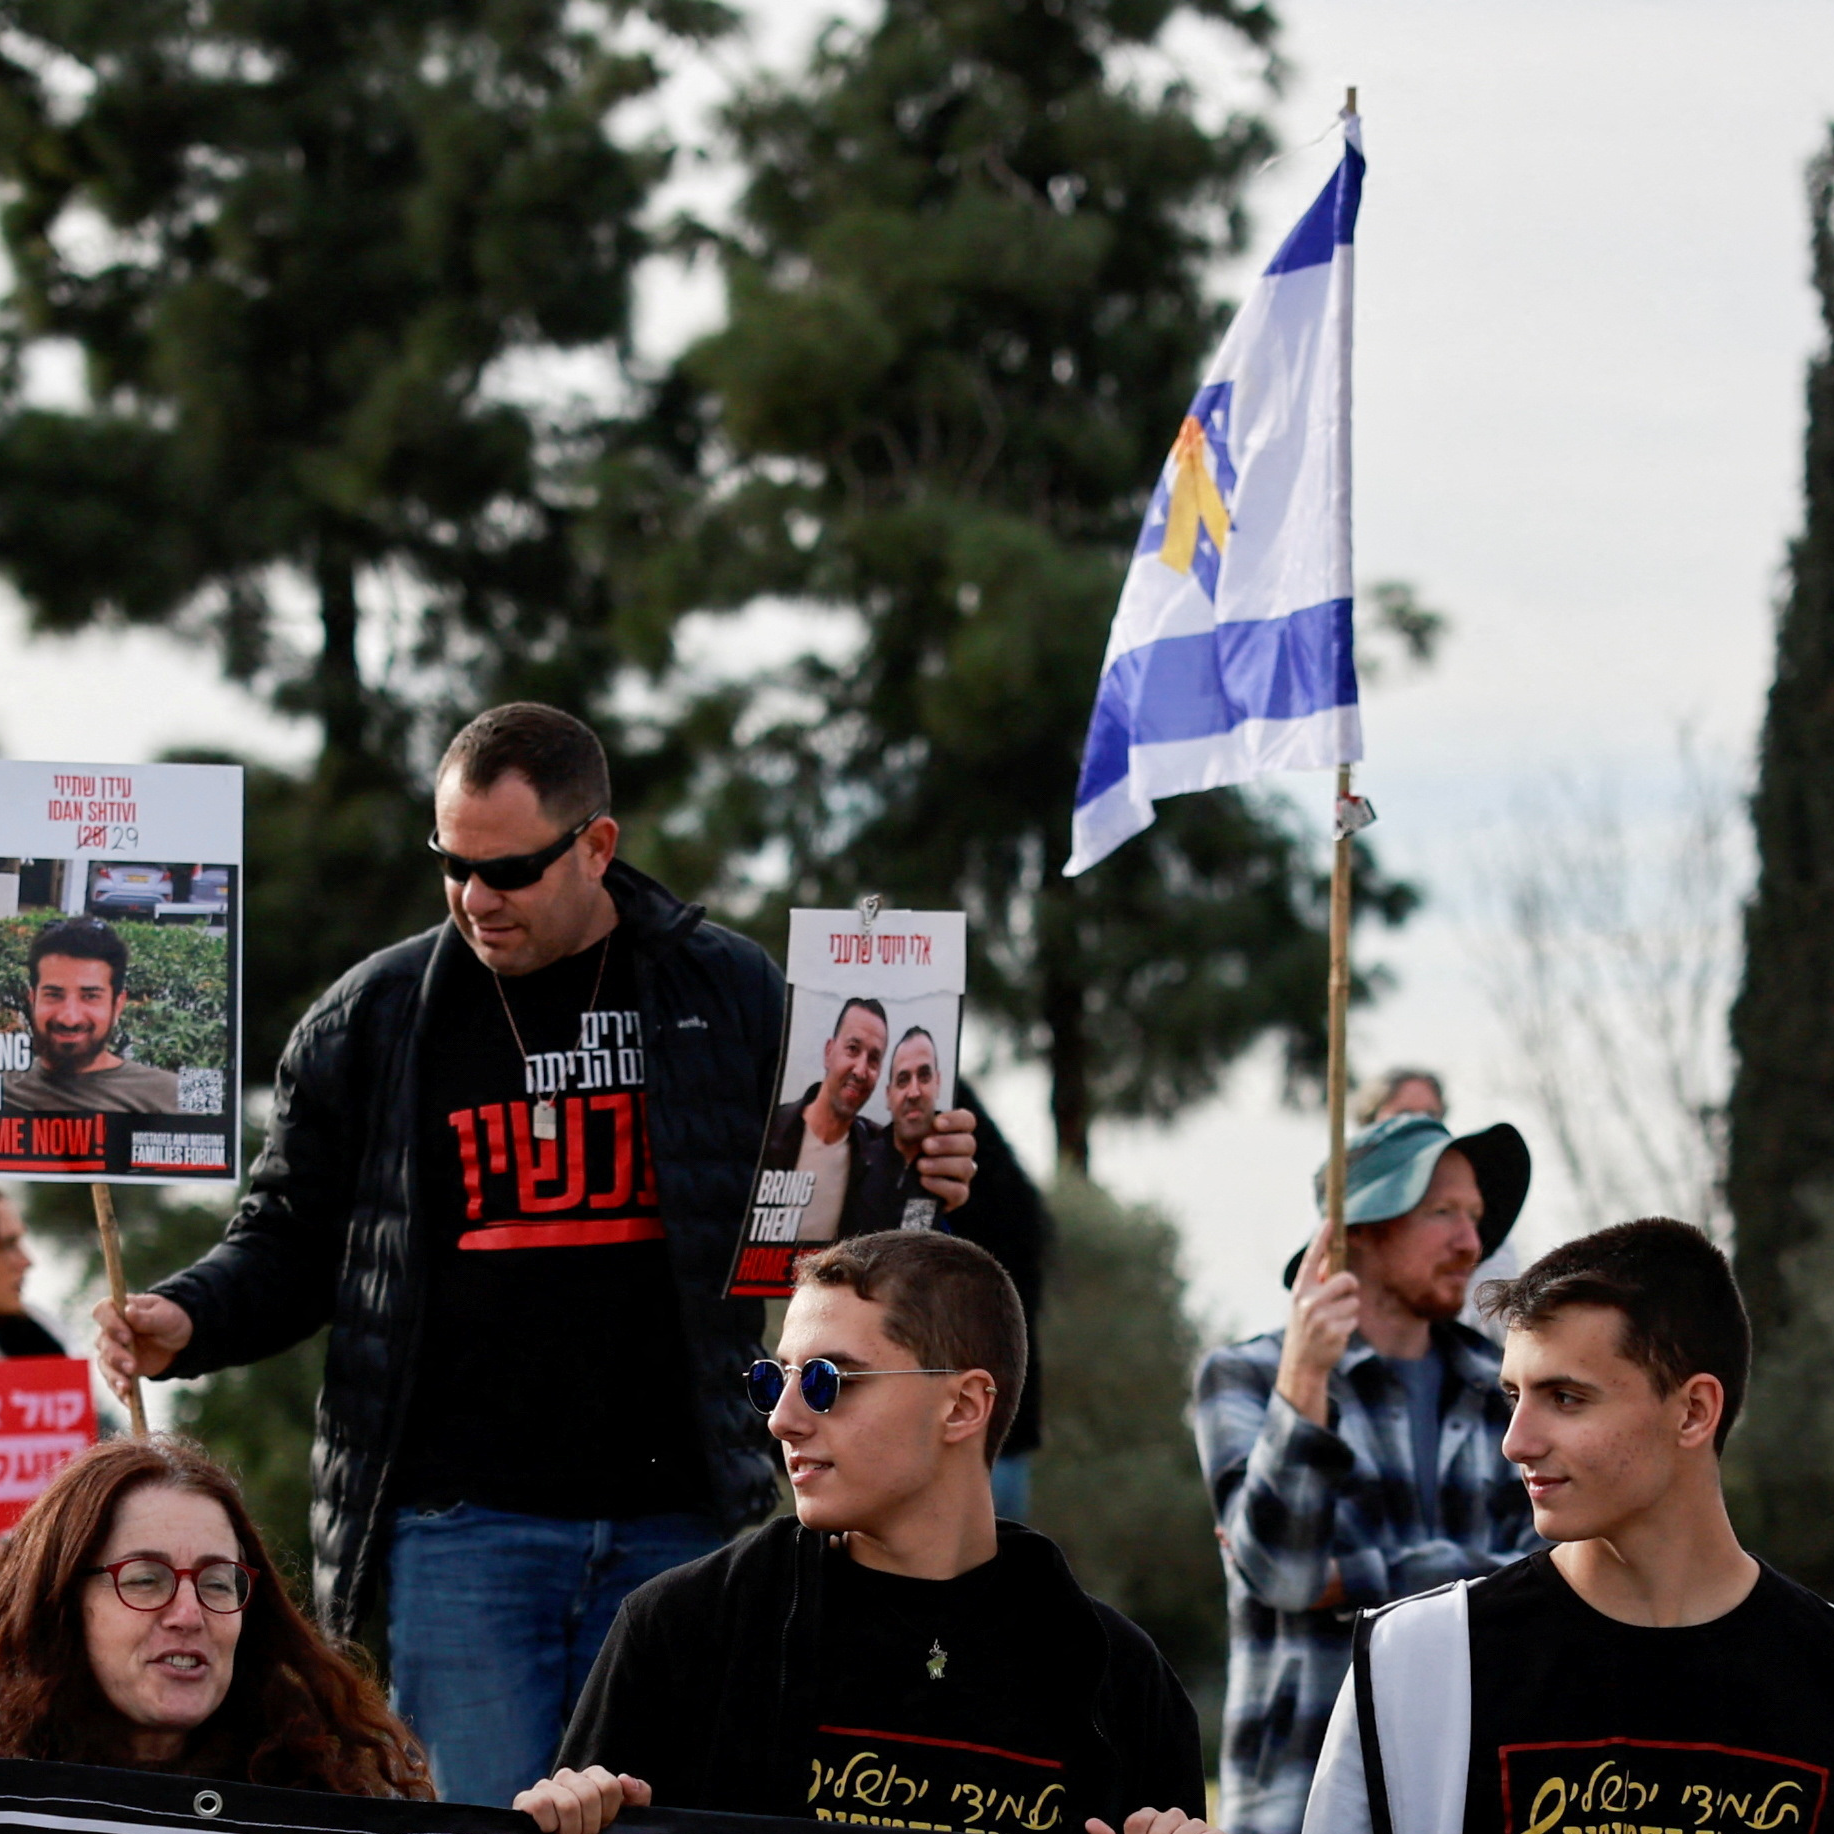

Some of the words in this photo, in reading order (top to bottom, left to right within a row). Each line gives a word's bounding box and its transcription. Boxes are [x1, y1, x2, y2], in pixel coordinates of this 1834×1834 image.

[54, 775, 96, 798] שתיוי
[101, 776, 132, 800] עידן
[48, 800, 83, 821] IDAN
[88, 801, 137, 823] SHTIVI
[112, 826, 139, 850] 29
[910, 932, 932, 965] אלי
[525, 1050, 613, 1093] הביתה
[32, 1114, 106, 1156] NOW!
[132, 1146, 182, 1164] FAMILIES
[184, 1147, 225, 1166] FORUM
[756, 1169, 816, 1206] BRING
[749, 1207, 803, 1242] THEM
[736, 1248, 793, 1281] HOME
[10, 1388, 85, 1429] קול
